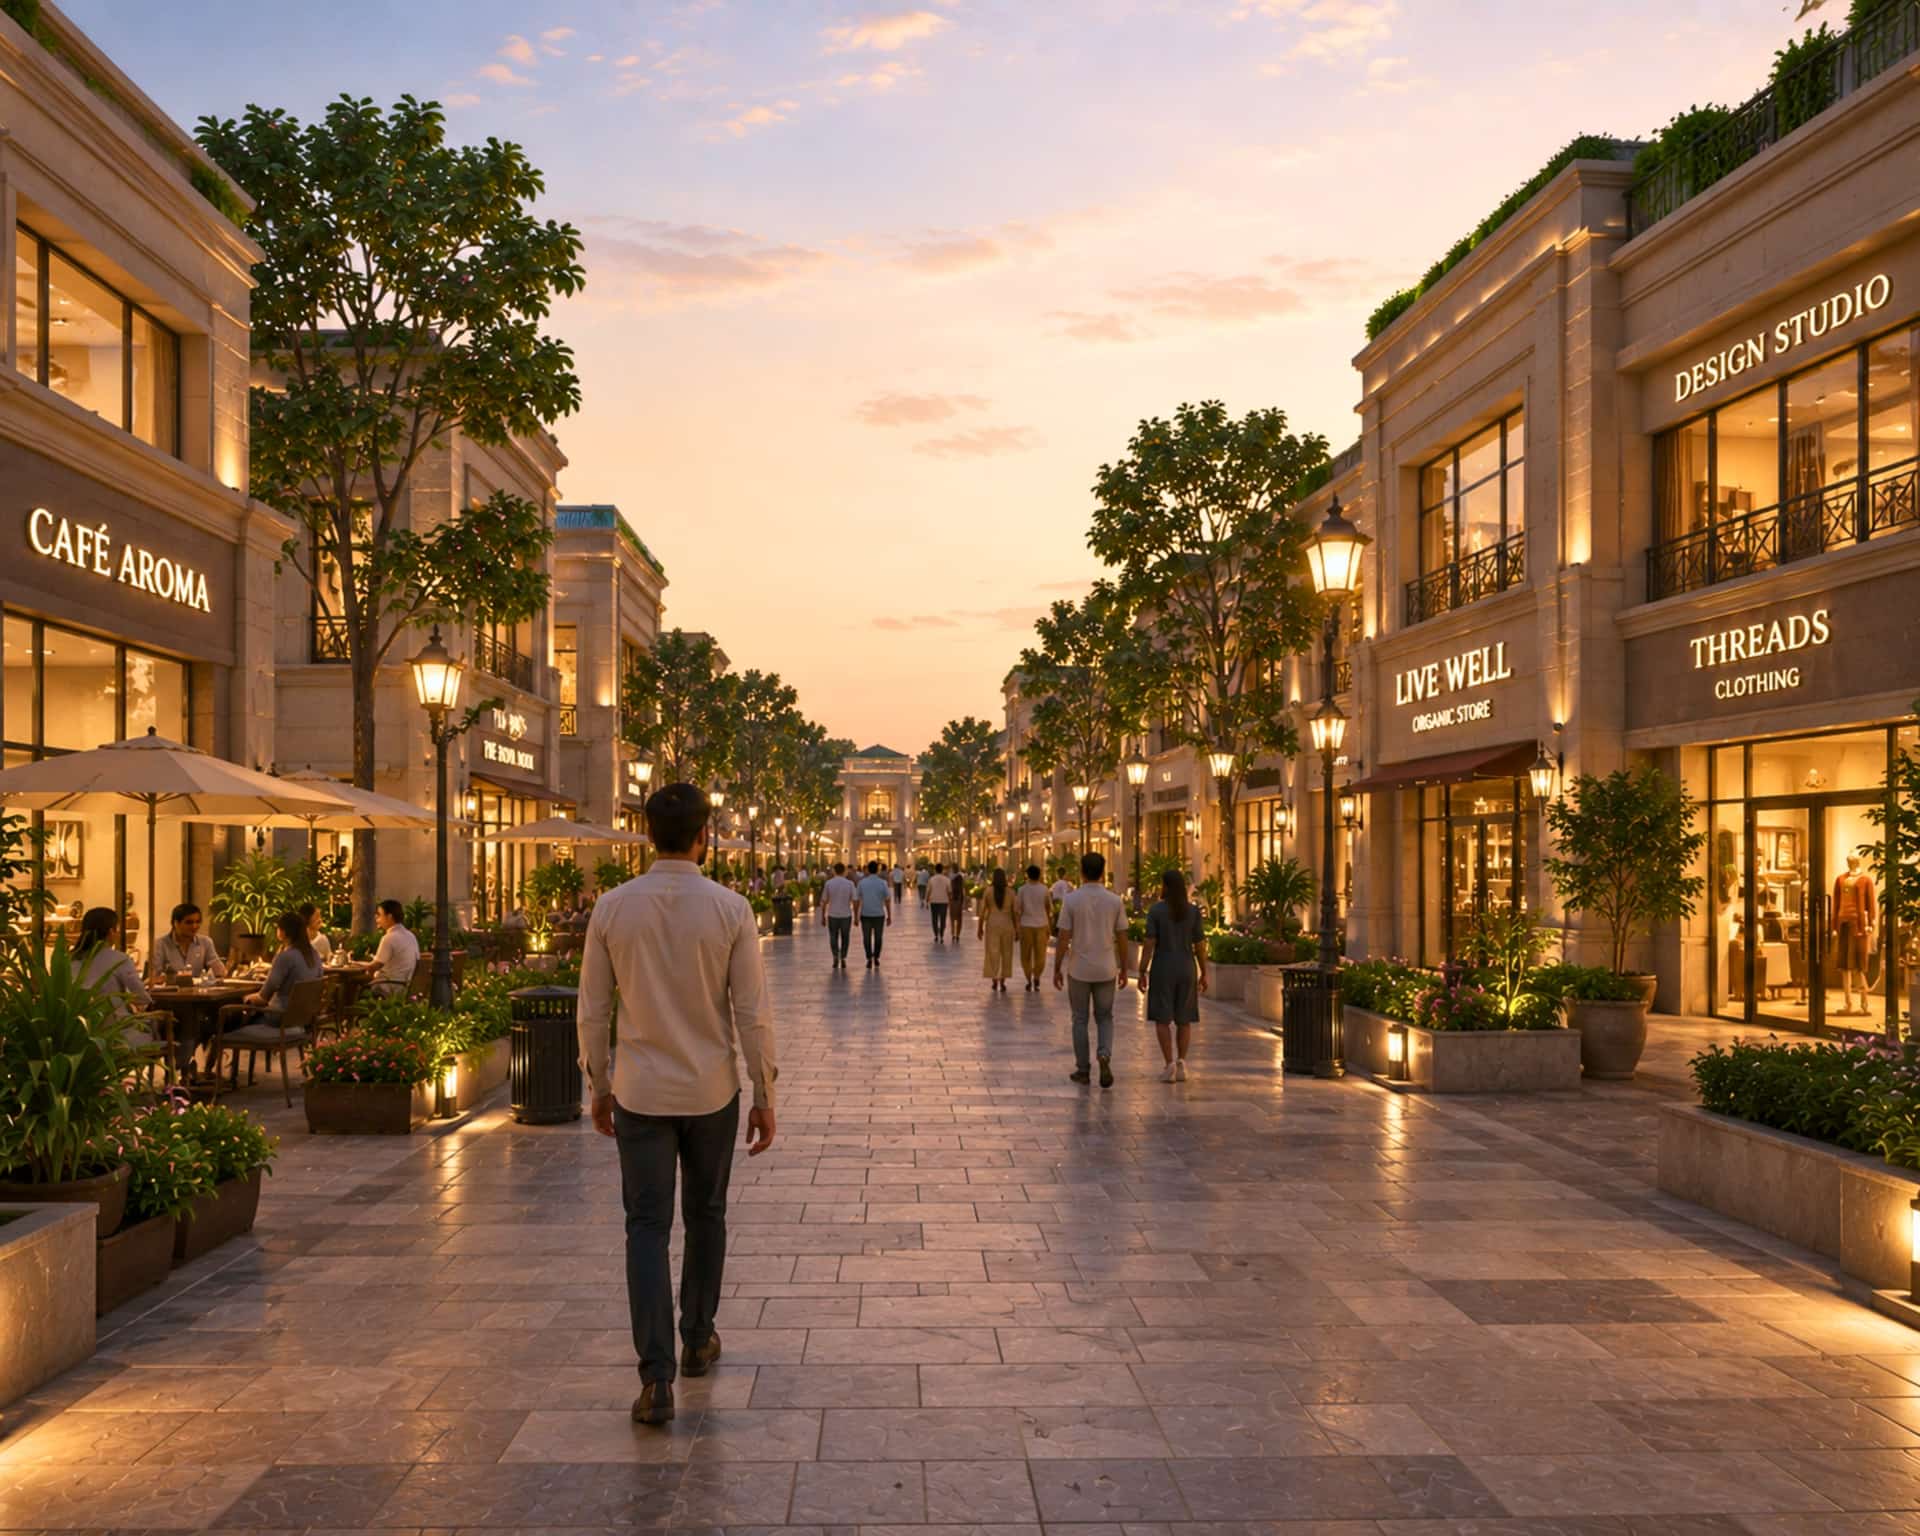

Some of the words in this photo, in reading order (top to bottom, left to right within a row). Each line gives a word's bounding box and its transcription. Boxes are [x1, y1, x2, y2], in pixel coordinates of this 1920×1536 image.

[1674, 332, 1767, 402] DESIGN
[1775, 274, 1890, 354] STUDIO
[29, 507, 111, 577] CAFÉ
[117, 543, 211, 613] AROMA
[1689, 608, 1830, 669] THREADS
[1395, 662, 1440, 706] LIVE
[1445, 641, 1511, 692] WELL
[1714, 667, 1800, 700] CLOTHING
[1412, 708, 1455, 733] ORGANIC
[1456, 699, 1491, 724] STORE
